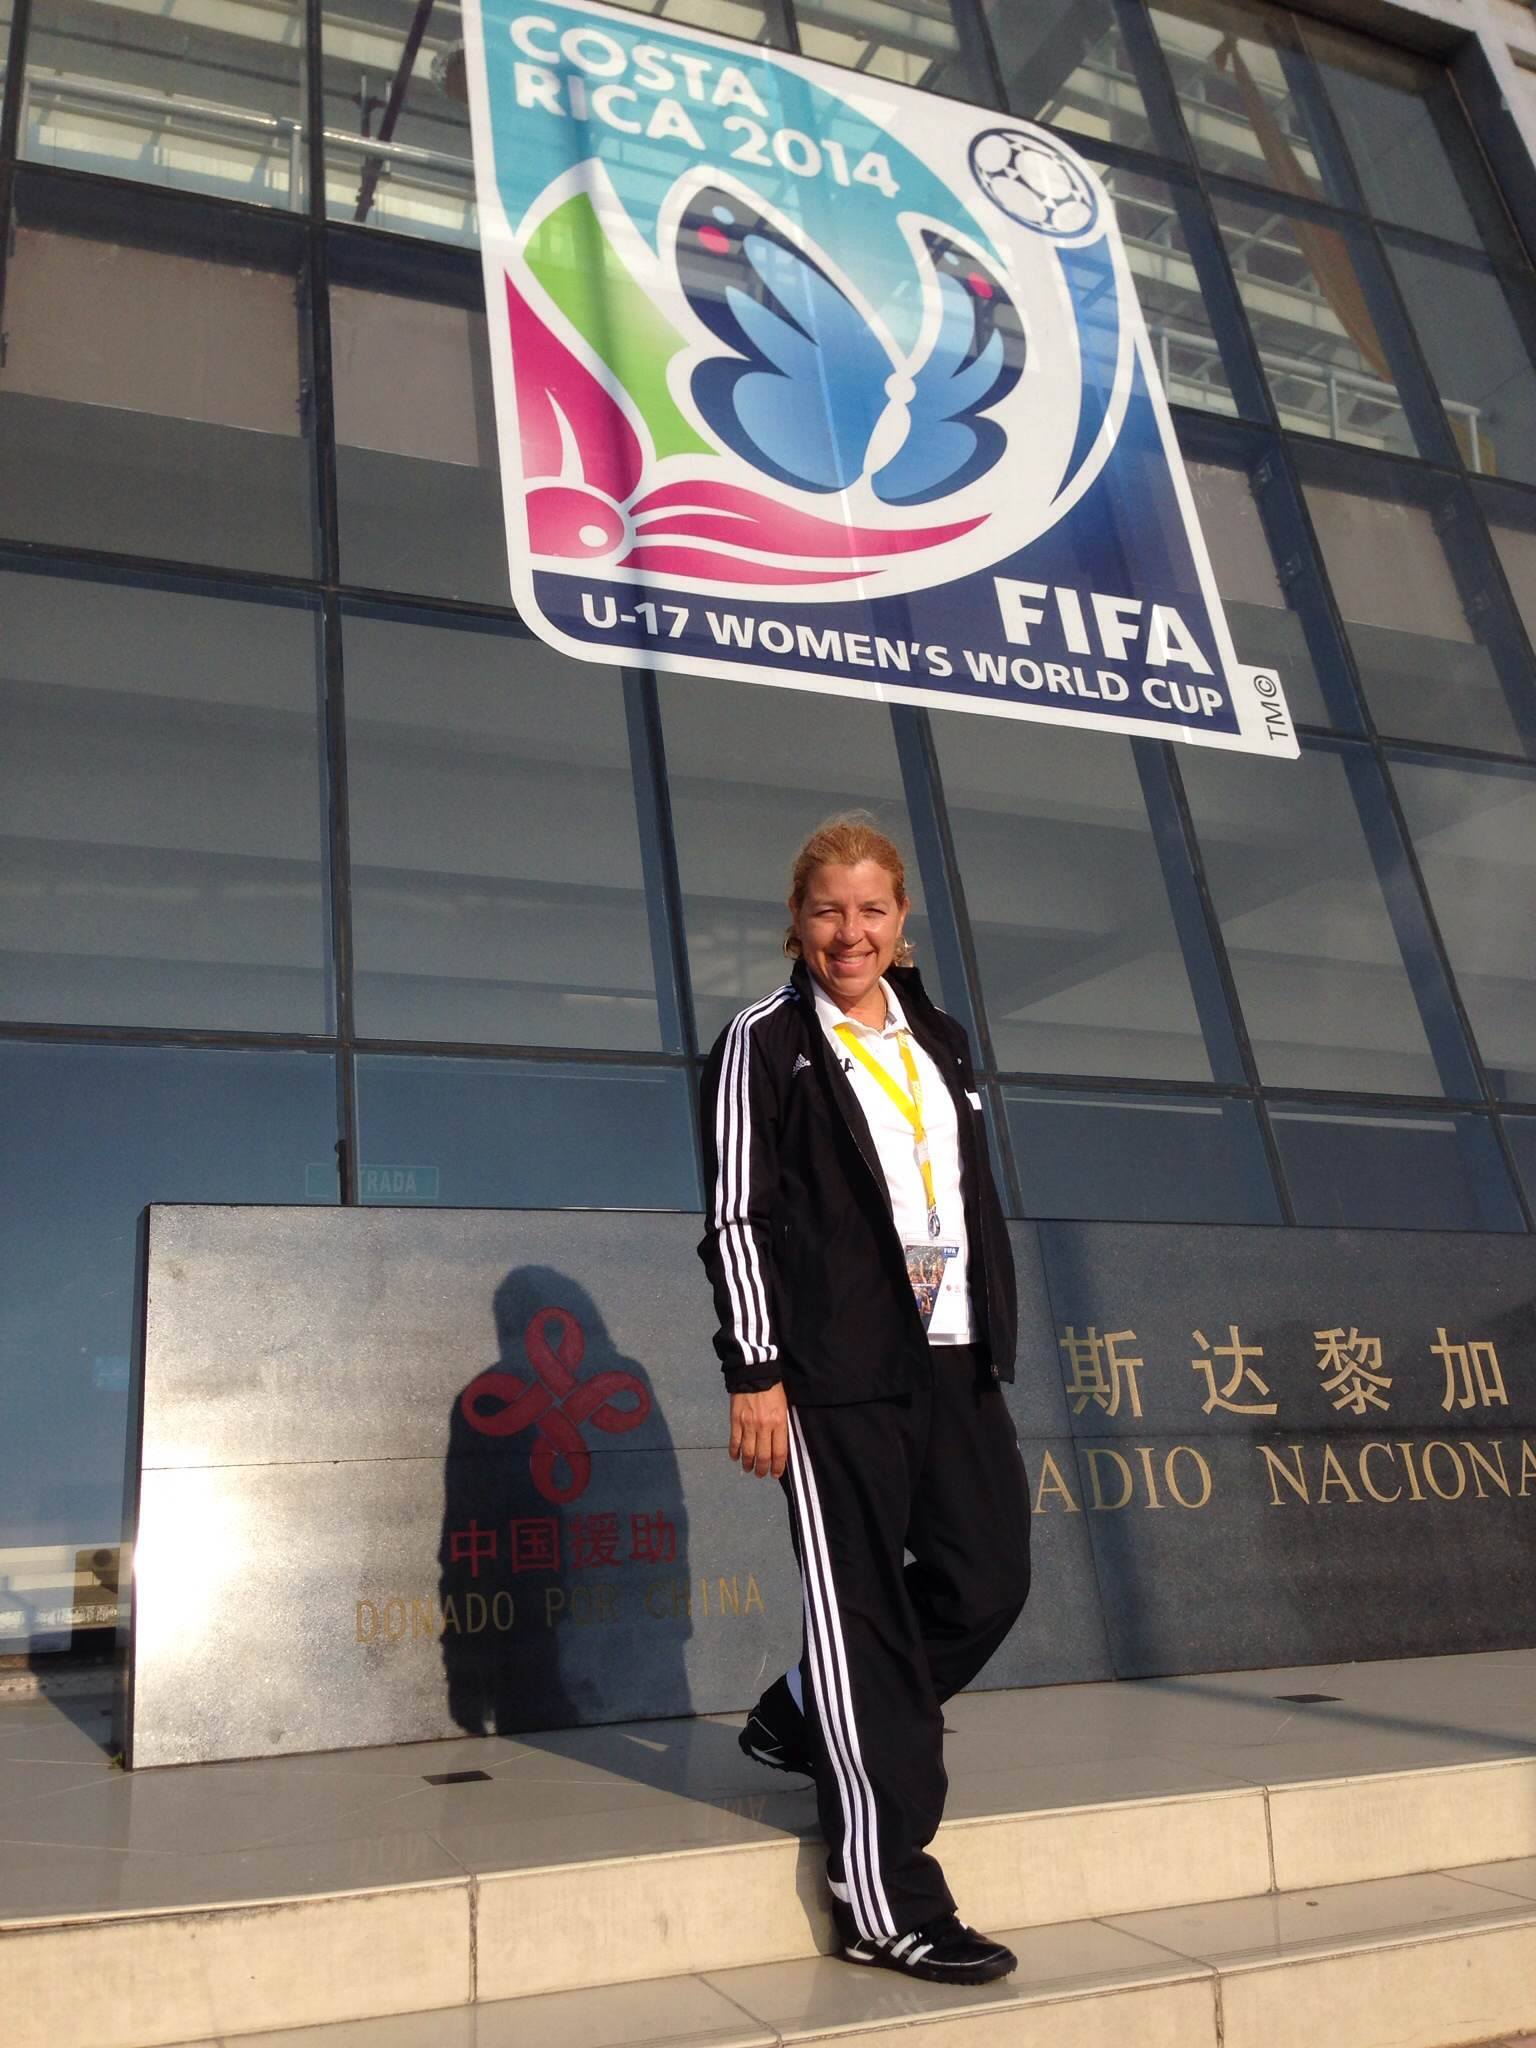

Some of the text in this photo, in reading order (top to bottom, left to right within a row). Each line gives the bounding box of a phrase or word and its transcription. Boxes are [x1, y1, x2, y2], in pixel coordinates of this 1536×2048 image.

[510, 15, 769, 117] COSTA
[513, 61, 900, 198] RICA 2014
[580, 592, 1224, 717] U-17 WOMEN'S WORLD CUP
[993, 576, 1215, 676] FIFA
[360, 1169, 416, 1193] RADA
[1059, 1325, 1510, 1417] 斯达黎加
[1031, 1445, 1212, 1514] ADIO
[450, 1509, 678, 1578] 中国援助
[355, 1572, 767, 1644] DONADO POR CHINA
